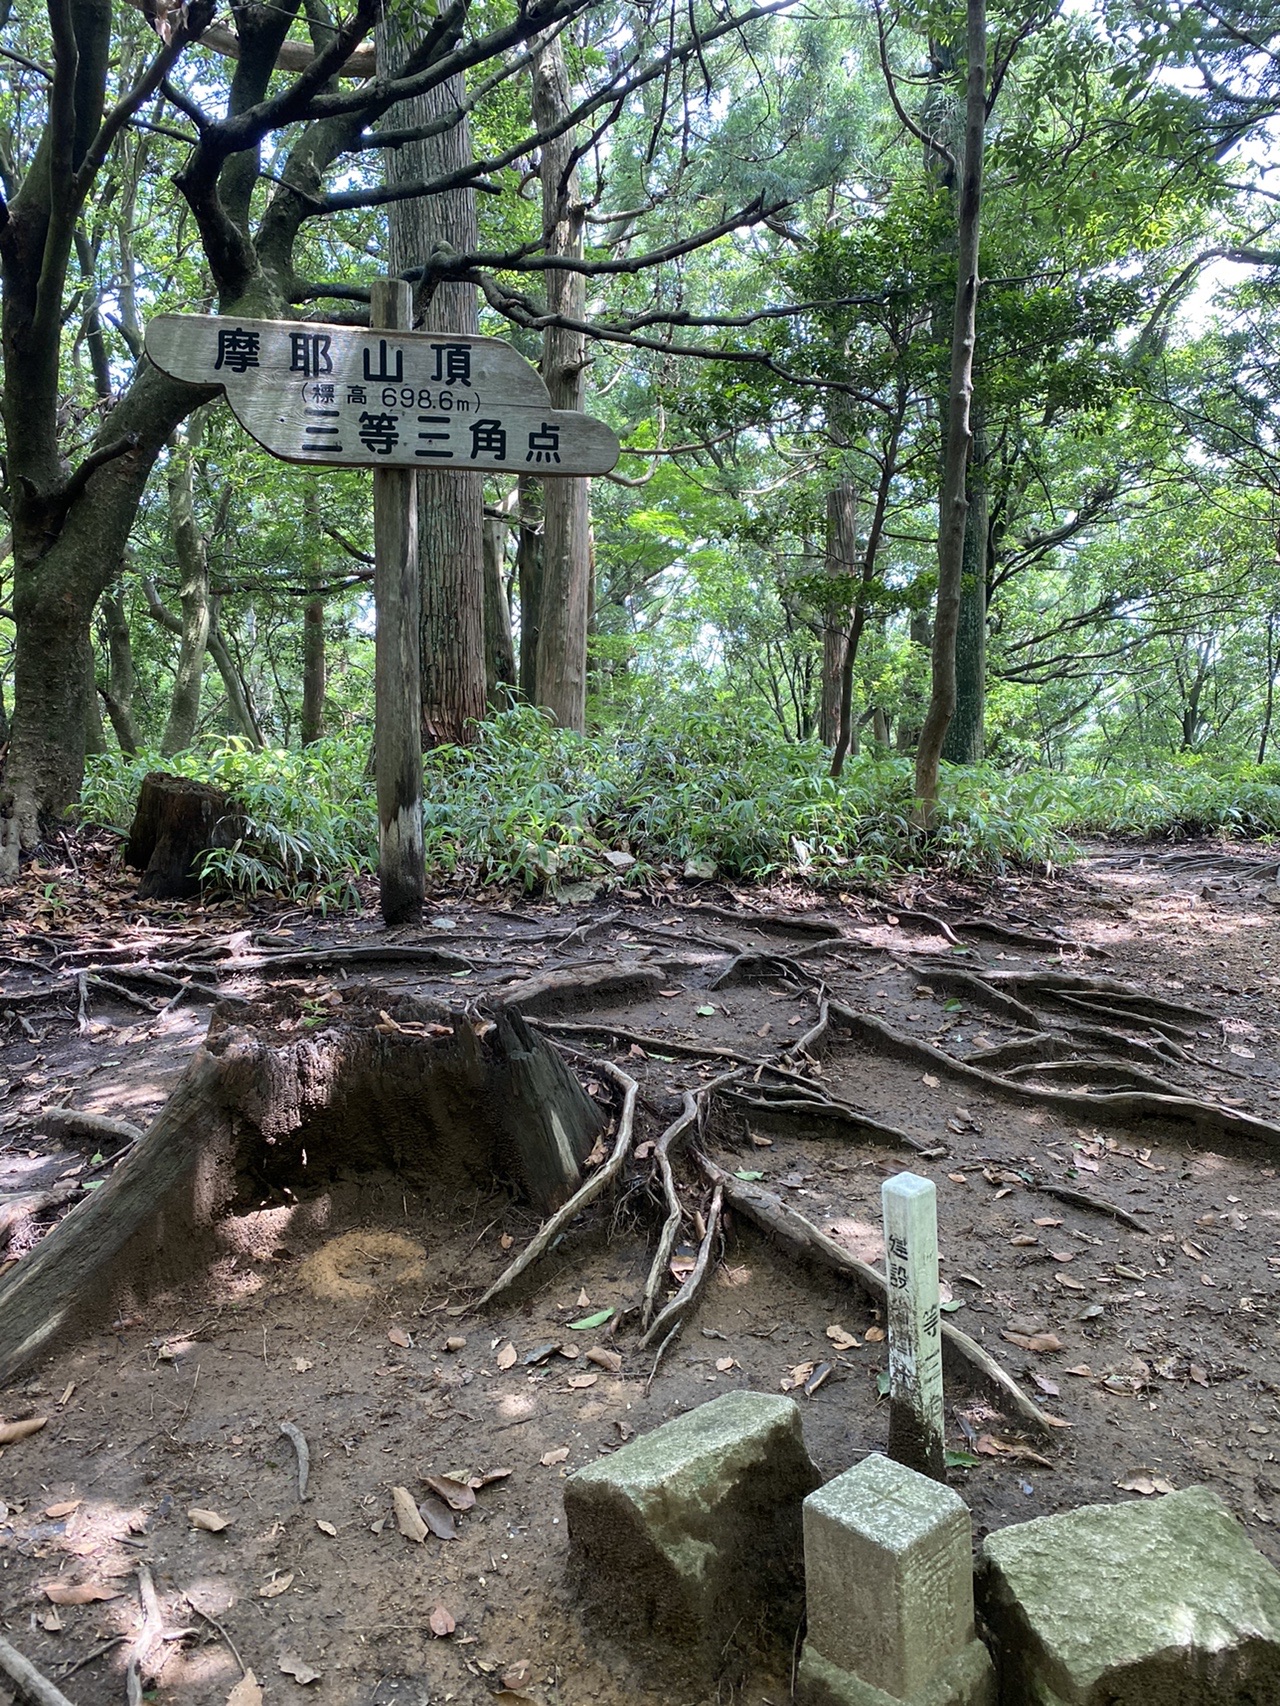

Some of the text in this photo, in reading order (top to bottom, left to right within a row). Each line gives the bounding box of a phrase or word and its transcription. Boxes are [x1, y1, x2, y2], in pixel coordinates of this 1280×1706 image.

[214, 328, 473, 387] 摩耶山頂
[302, 409, 562, 463] 三等三角点
